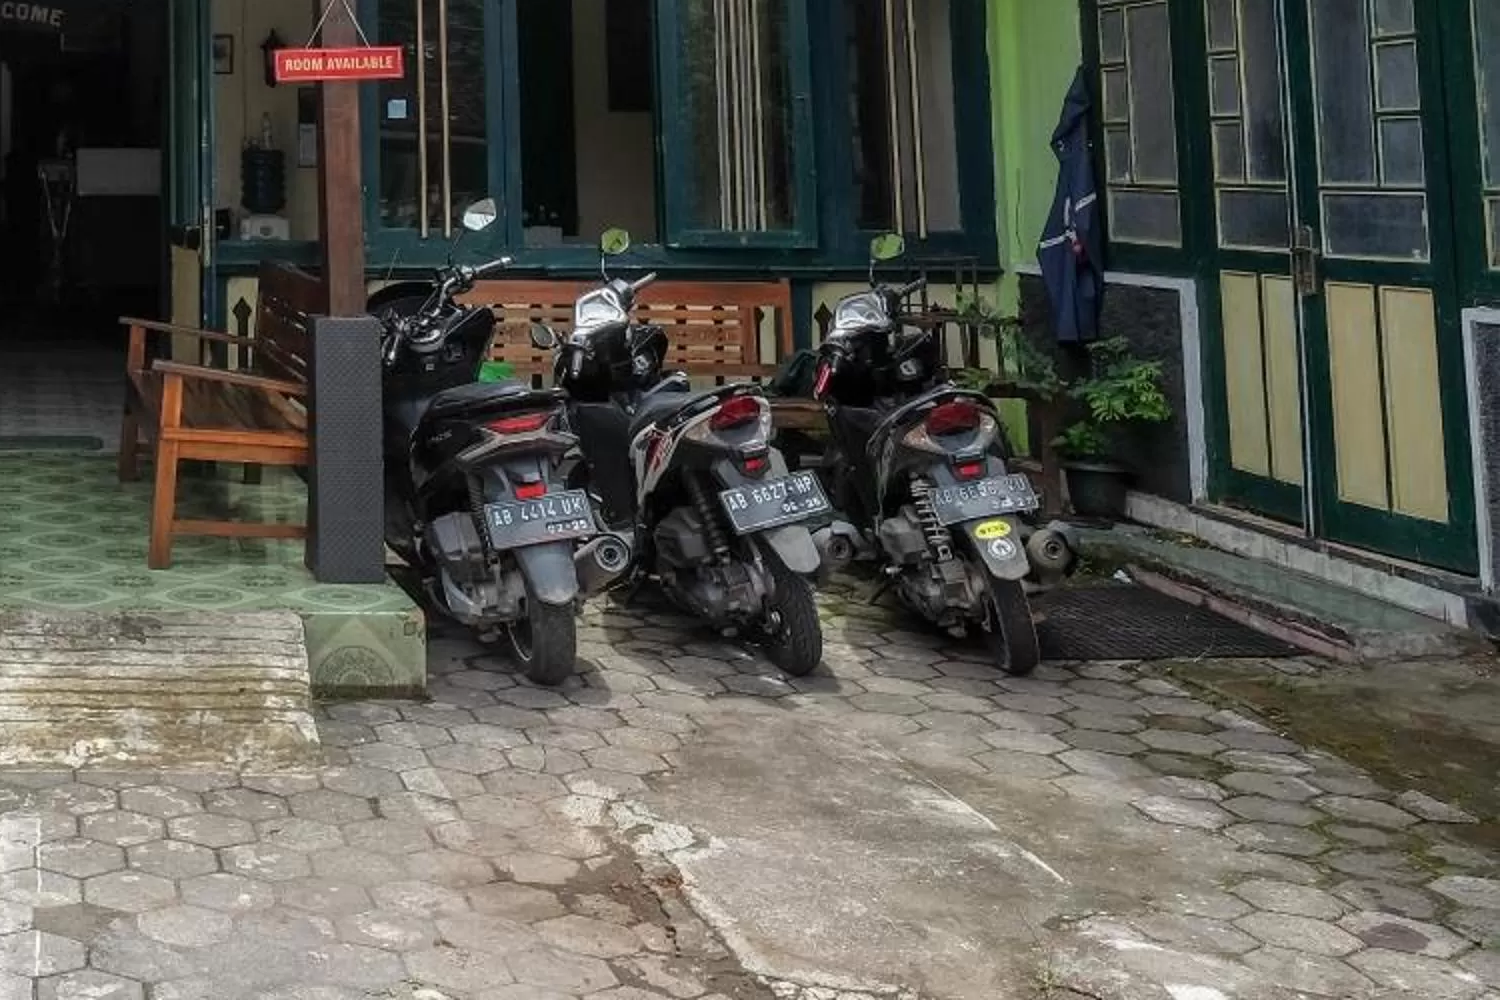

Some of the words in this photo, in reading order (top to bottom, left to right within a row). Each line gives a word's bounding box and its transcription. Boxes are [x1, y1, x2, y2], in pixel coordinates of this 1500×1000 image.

[284, 58, 323, 73] ROOM
[326, 55, 394, 71] AVAILABLE
[728, 492, 749, 511] AB
[492, 508, 513, 527] AB
